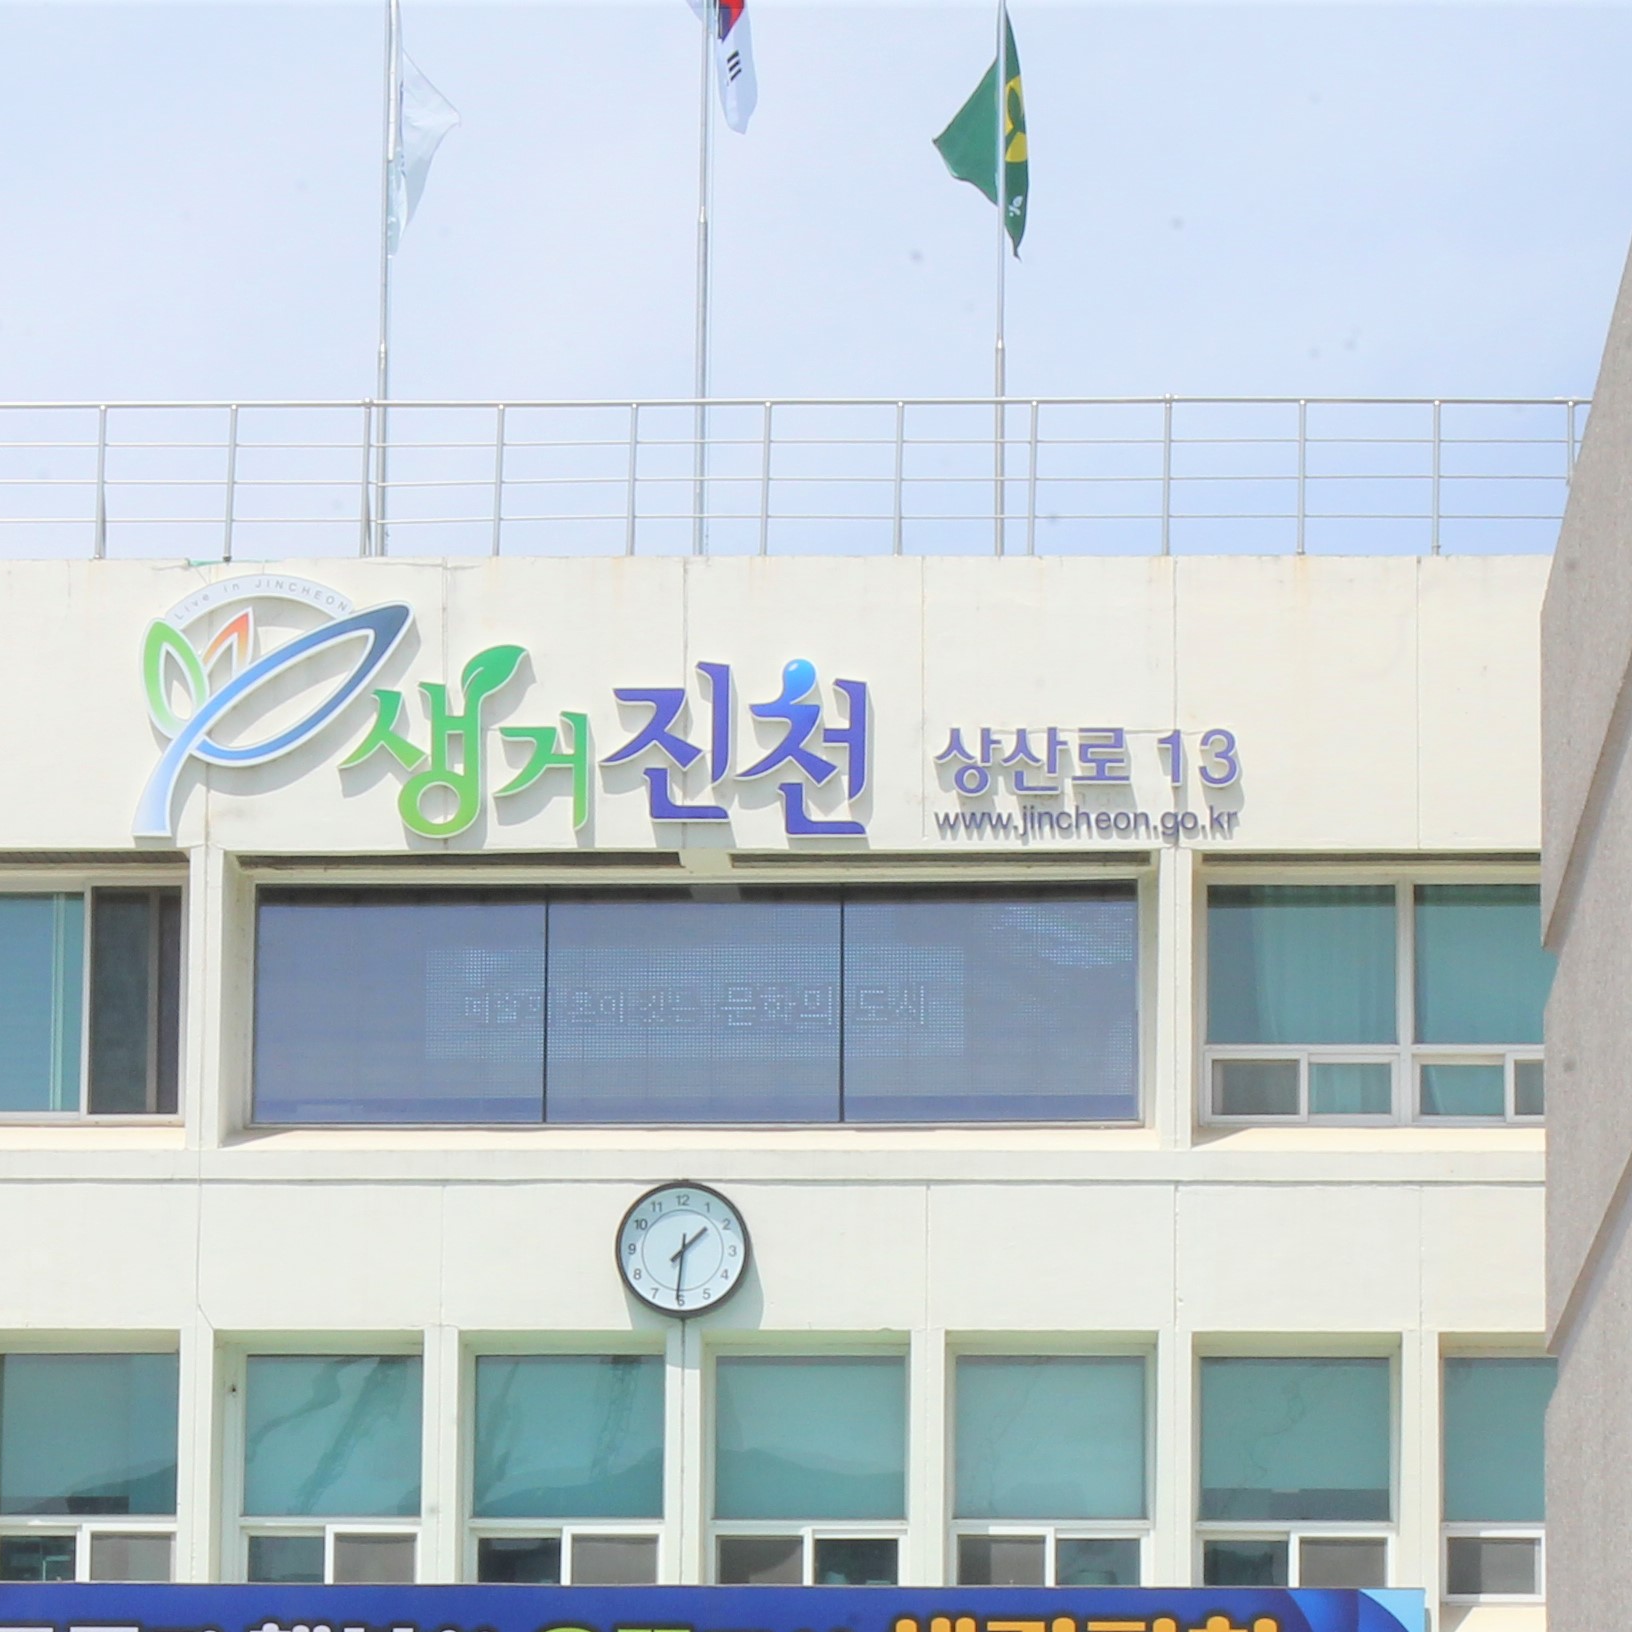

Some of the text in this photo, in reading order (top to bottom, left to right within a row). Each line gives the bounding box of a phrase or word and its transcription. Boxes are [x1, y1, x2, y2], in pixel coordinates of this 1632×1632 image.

[174, 579, 348, 621] Live in JINCHEON
[338, 648, 868, 838] 생거진천
[934, 727, 1237, 794] 상산로 13
[934, 805, 1238, 837] www.jincheon.go.kr
[856, 984, 924, 1026] 도시
[676, 1194, 690, 1206] 12
[650, 1201, 663, 1213] 11
[705, 1202, 711, 1213] 1
[634, 1218, 649, 1231] 10
[722, 1218, 731, 1231] 2
[628, 1243, 636, 1255] 9
[728, 1245, 737, 1257] 3
[633, 1268, 642, 1280] 8
[720, 1269, 729, 1280] 4
[650, 1288, 659, 1299] 7
[703, 1288, 711, 1300] 5
[677, 1294, 685, 1307] 6
